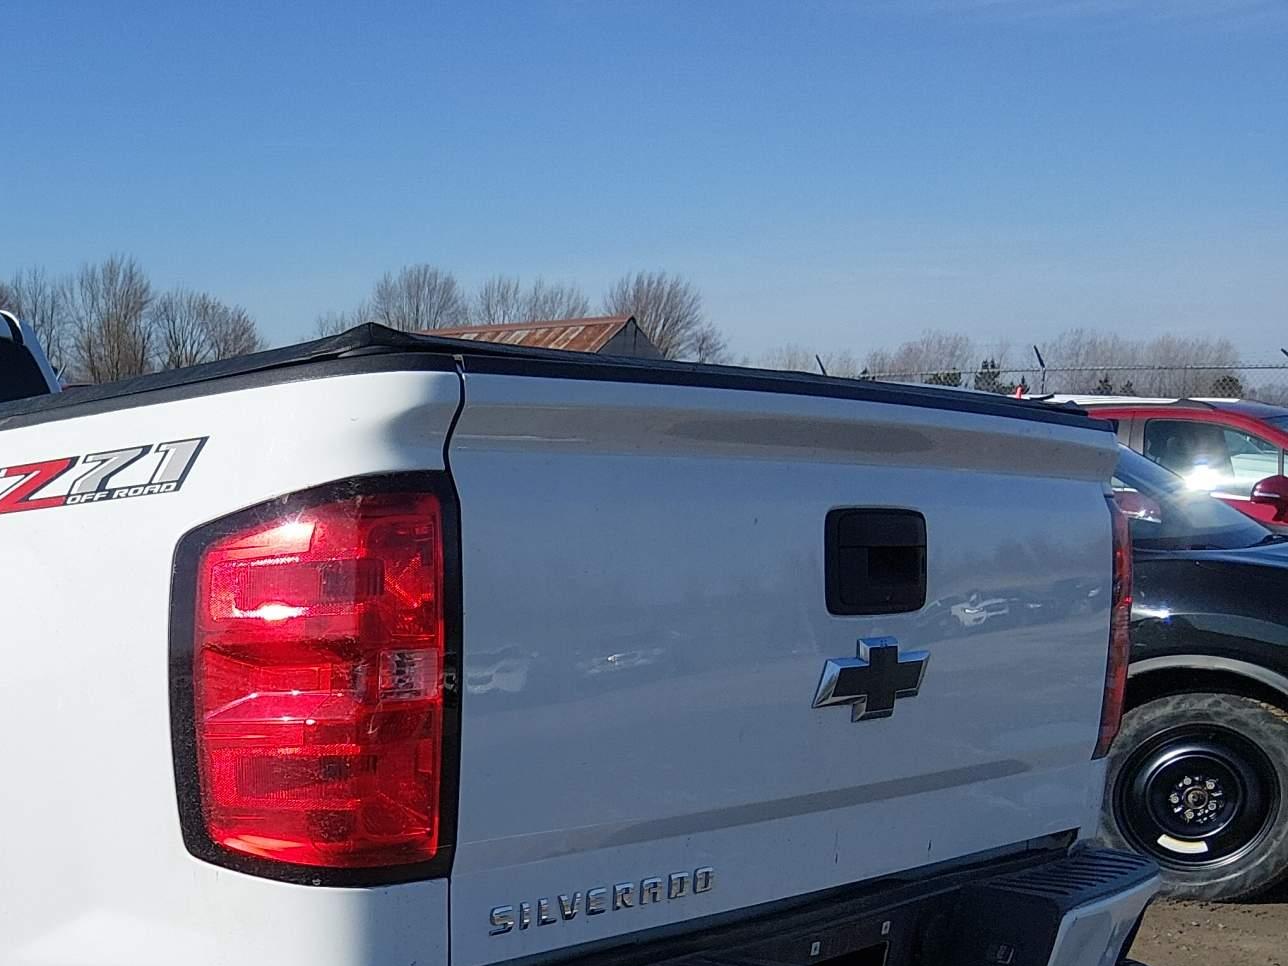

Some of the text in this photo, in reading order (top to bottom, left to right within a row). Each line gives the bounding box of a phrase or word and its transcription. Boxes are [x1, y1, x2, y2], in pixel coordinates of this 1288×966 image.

[66, 482, 178, 505] OFF ROAD
[488, 866, 715, 937] SILVERADO
